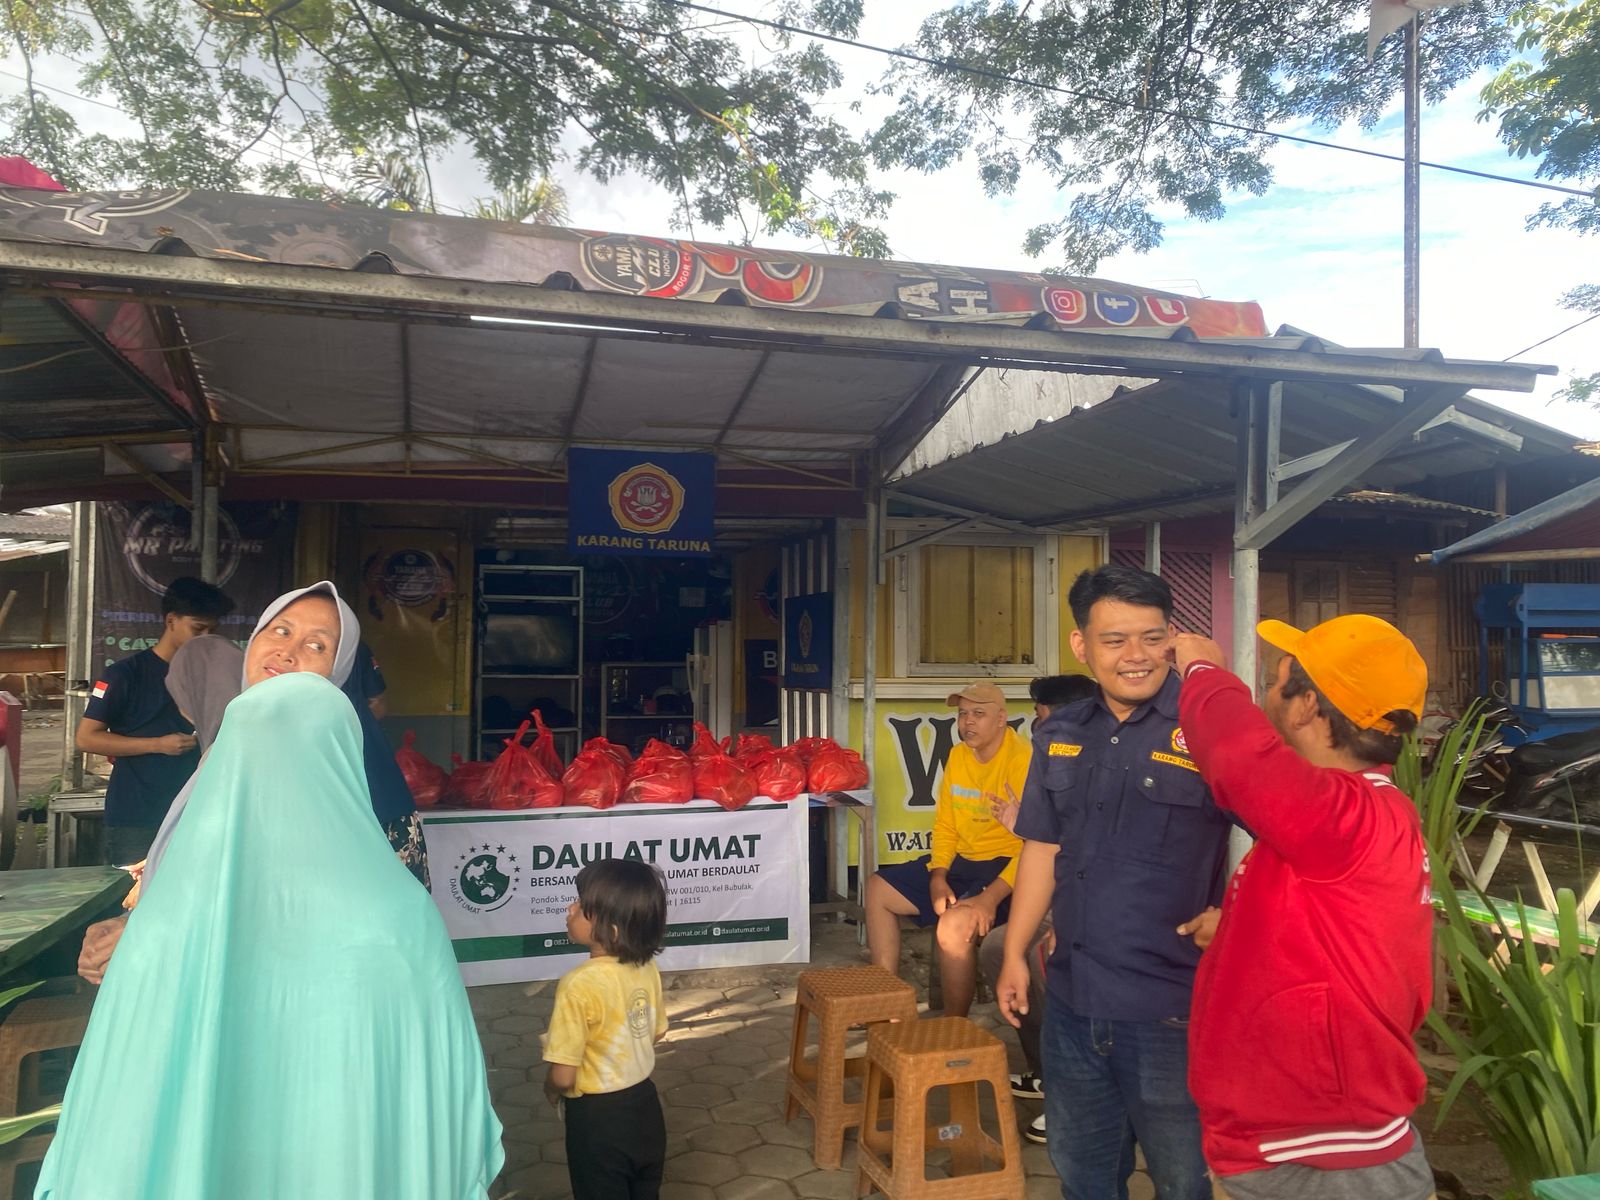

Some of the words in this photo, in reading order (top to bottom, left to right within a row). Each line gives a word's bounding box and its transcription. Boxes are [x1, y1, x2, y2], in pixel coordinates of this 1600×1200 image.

[615, 246, 632, 277] YAMA
[647, 248, 661, 278] CLU
[577, 535, 643, 549] KARANG
[647, 538, 711, 552] TARUNA
[532, 839, 662, 871] DAULAT
[669, 834, 762, 863] UMAT
[530, 876, 578, 888] BERSAM
[667, 868, 699, 880] UMAT
[701, 864, 761, 877] BERDAULAT
[531, 895, 559, 904] Pondok
[712, 884, 723, 892] Kel
[545, 907, 568, 915] Bogor
[680, 896, 701, 905] 16115
[665, 928, 708, 938] ulatumat.or.id
